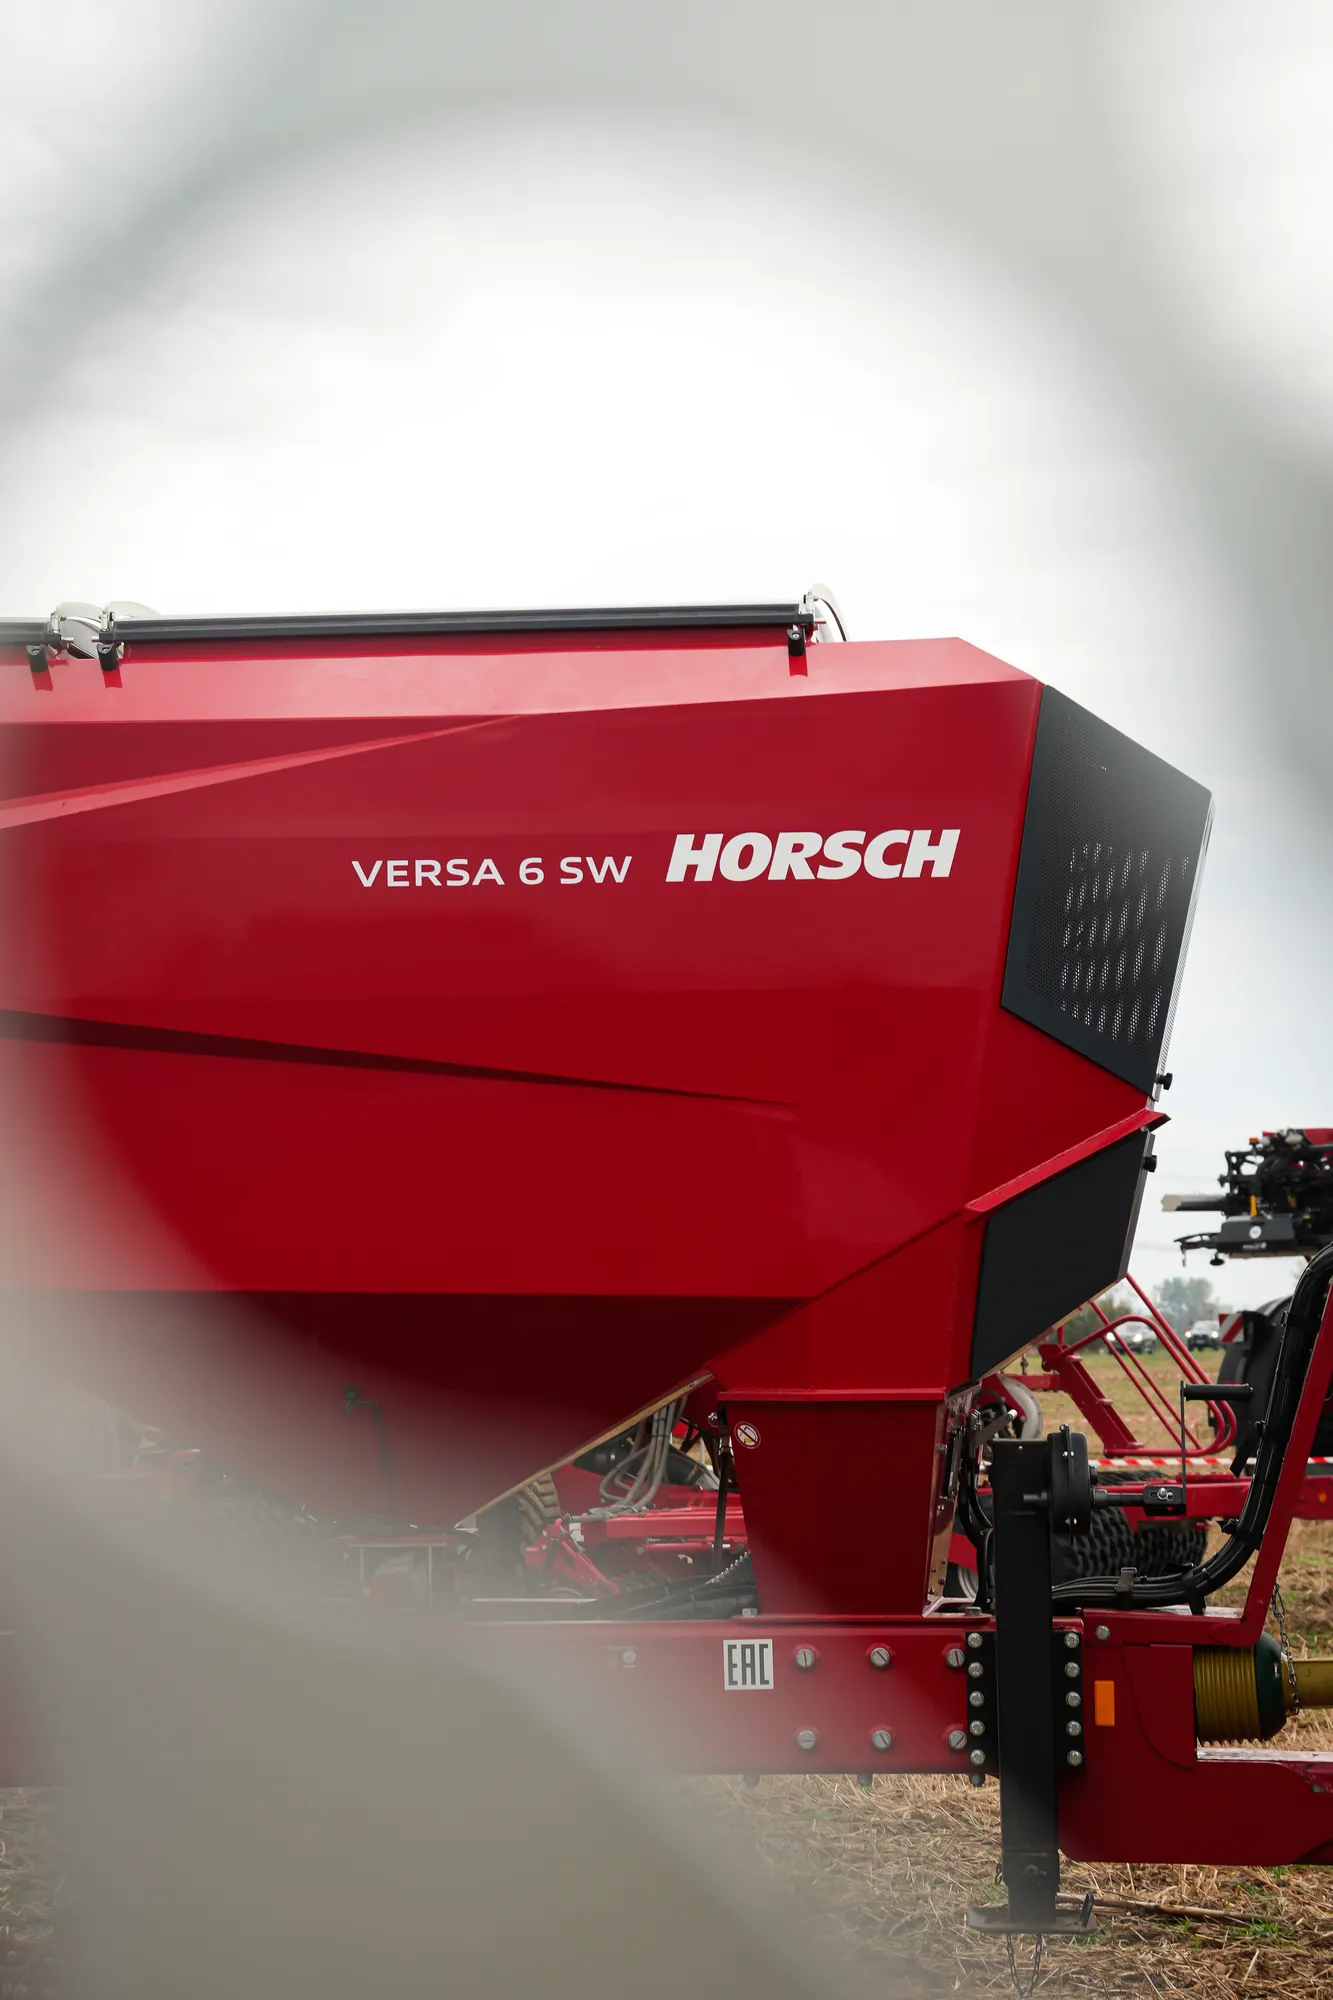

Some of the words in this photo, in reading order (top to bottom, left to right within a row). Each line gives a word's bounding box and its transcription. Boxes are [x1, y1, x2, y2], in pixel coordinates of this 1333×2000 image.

[351, 858, 505, 888] VERSA
[518, 857, 545, 886] 6
[559, 856, 633, 885] SW
[665, 829, 961, 883] HORSCH
[727, 1643, 770, 1686] EAC
